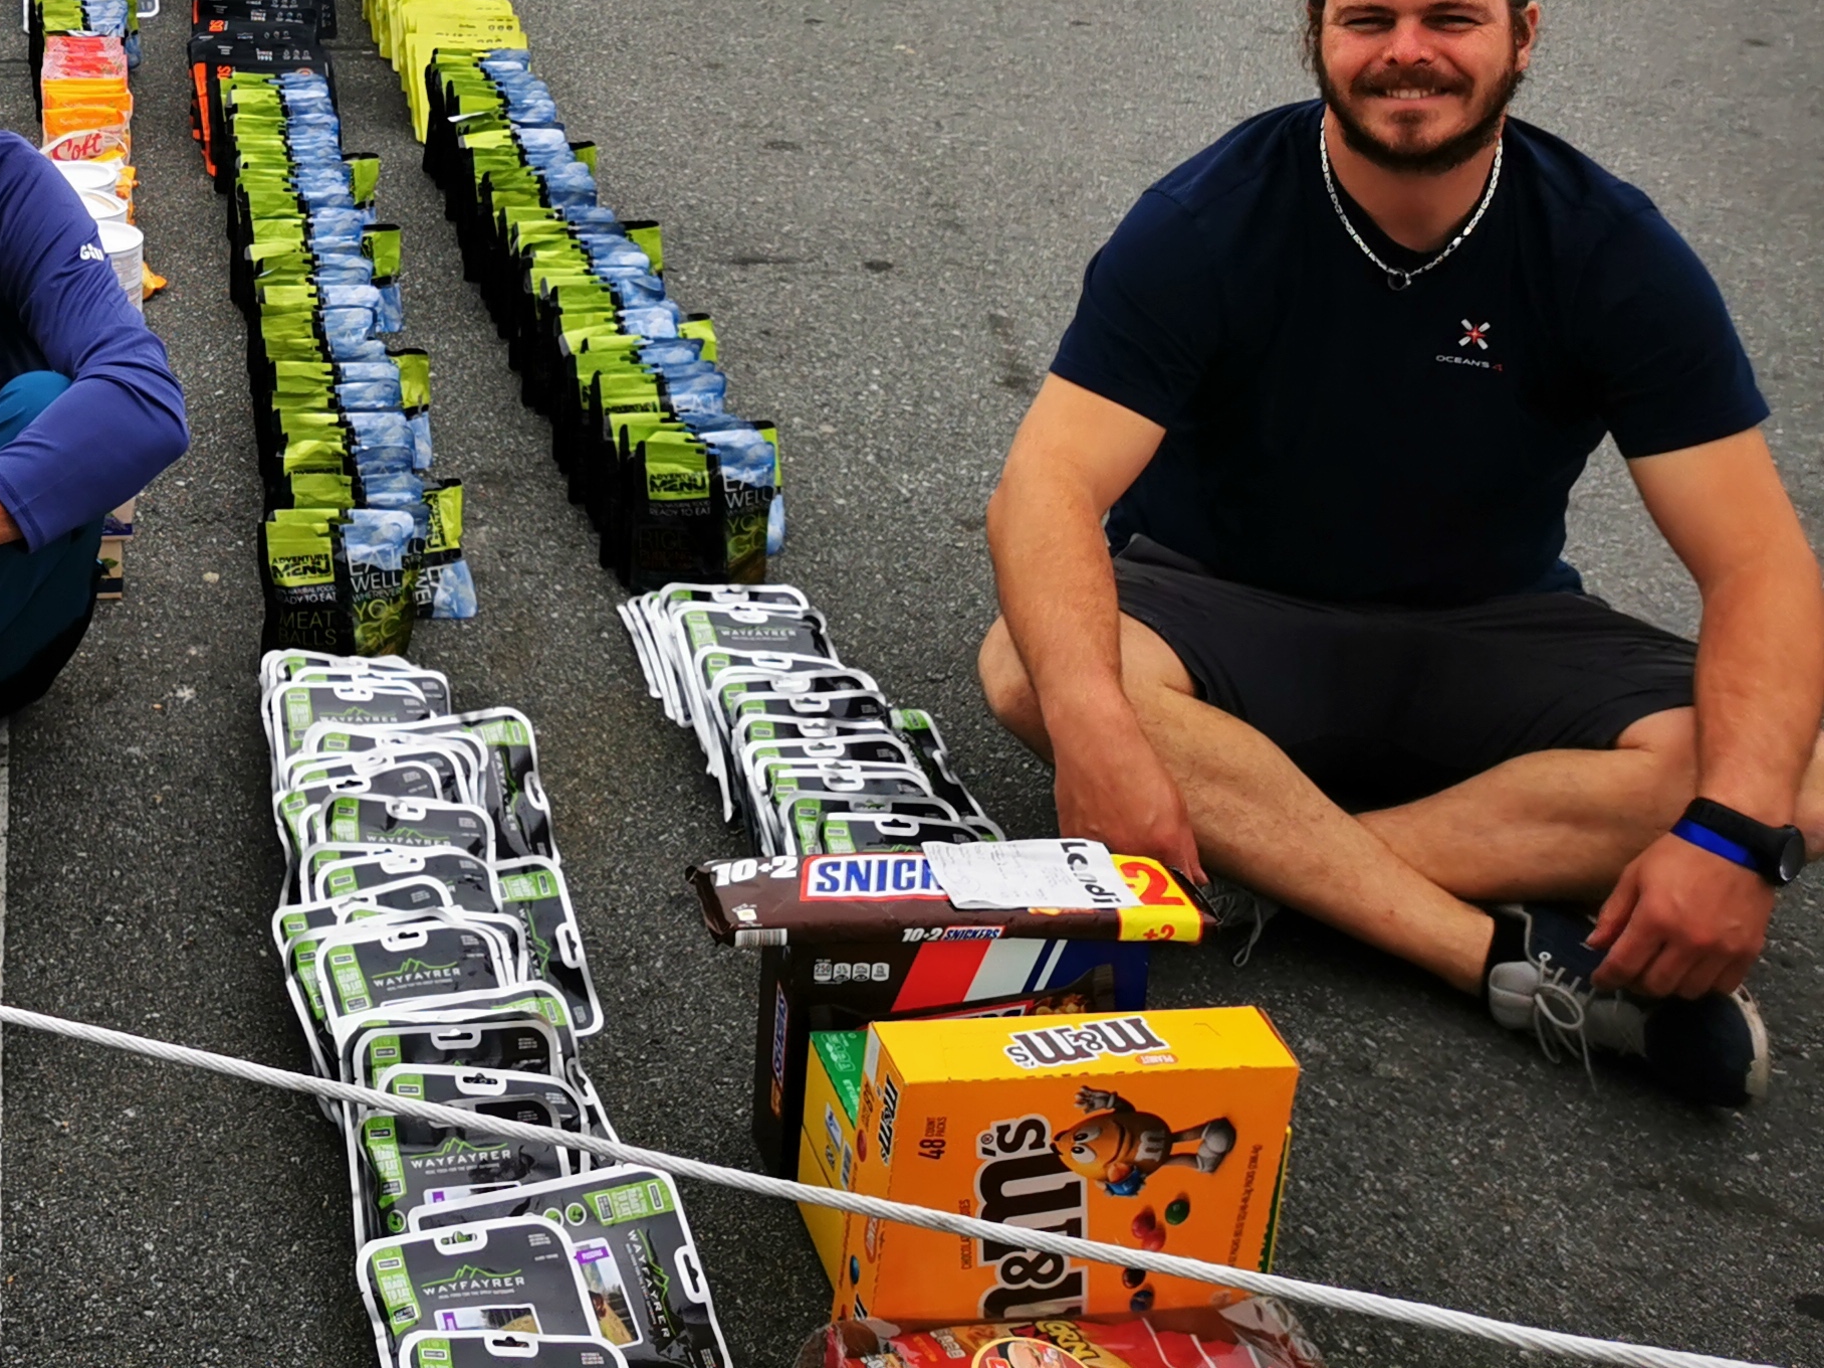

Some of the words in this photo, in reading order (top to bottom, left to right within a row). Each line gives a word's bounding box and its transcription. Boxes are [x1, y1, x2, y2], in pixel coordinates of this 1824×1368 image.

[1435, 354, 1490, 369] OCEAN'S
[649, 478, 707, 493] MENU
[272, 553, 330, 565] ADVENTURE
[270, 560, 331, 579] MENU
[350, 571, 401, 593] WELL
[279, 609, 337, 630] MEAT
[279, 628, 337, 647] BALLS
[710, 856, 798, 887] 10+2
[942, 926, 1004, 941] SNICKERS
[373, 968, 462, 988] WAYFAYRER
[1140, 1053, 1175, 1065] PEANUT
[925, 1116, 936, 1138] COUNT
[935, 1116, 947, 1137] PACKS
[411, 1149, 512, 1169] WAYFAYRER
[918, 1138, 946, 1160] 48
[422, 1276, 526, 1296] WAYFAYRER
[627, 1229, 671, 1338] WAYFAYRER
